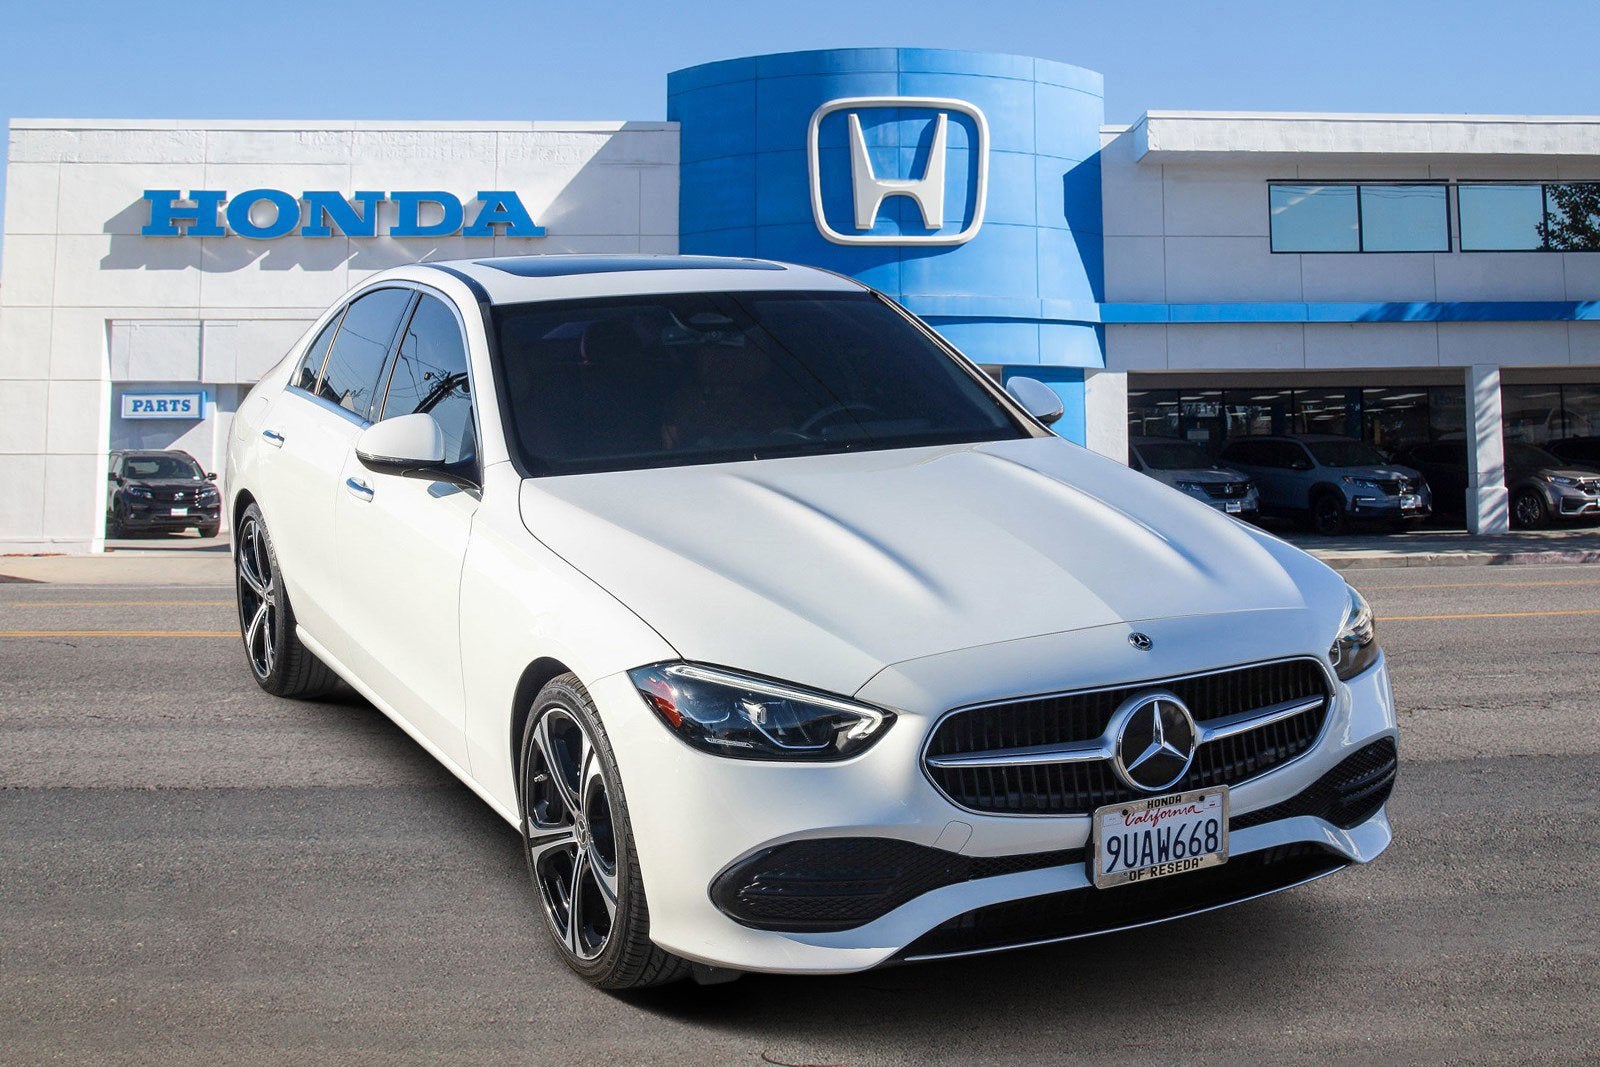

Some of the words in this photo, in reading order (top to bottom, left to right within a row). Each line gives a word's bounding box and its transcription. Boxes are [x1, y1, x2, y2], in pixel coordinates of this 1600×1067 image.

[141, 188, 547, 239] HONDA
[132, 399, 191, 412] PARTS
[1147, 795, 1182, 809] HONDA
[1124, 804, 1204, 828] California
[1106, 818, 1219, 873] 9UAW668
[1129, 868, 1146, 881] OF
[1150, 858, 1199, 877] RESEDA
